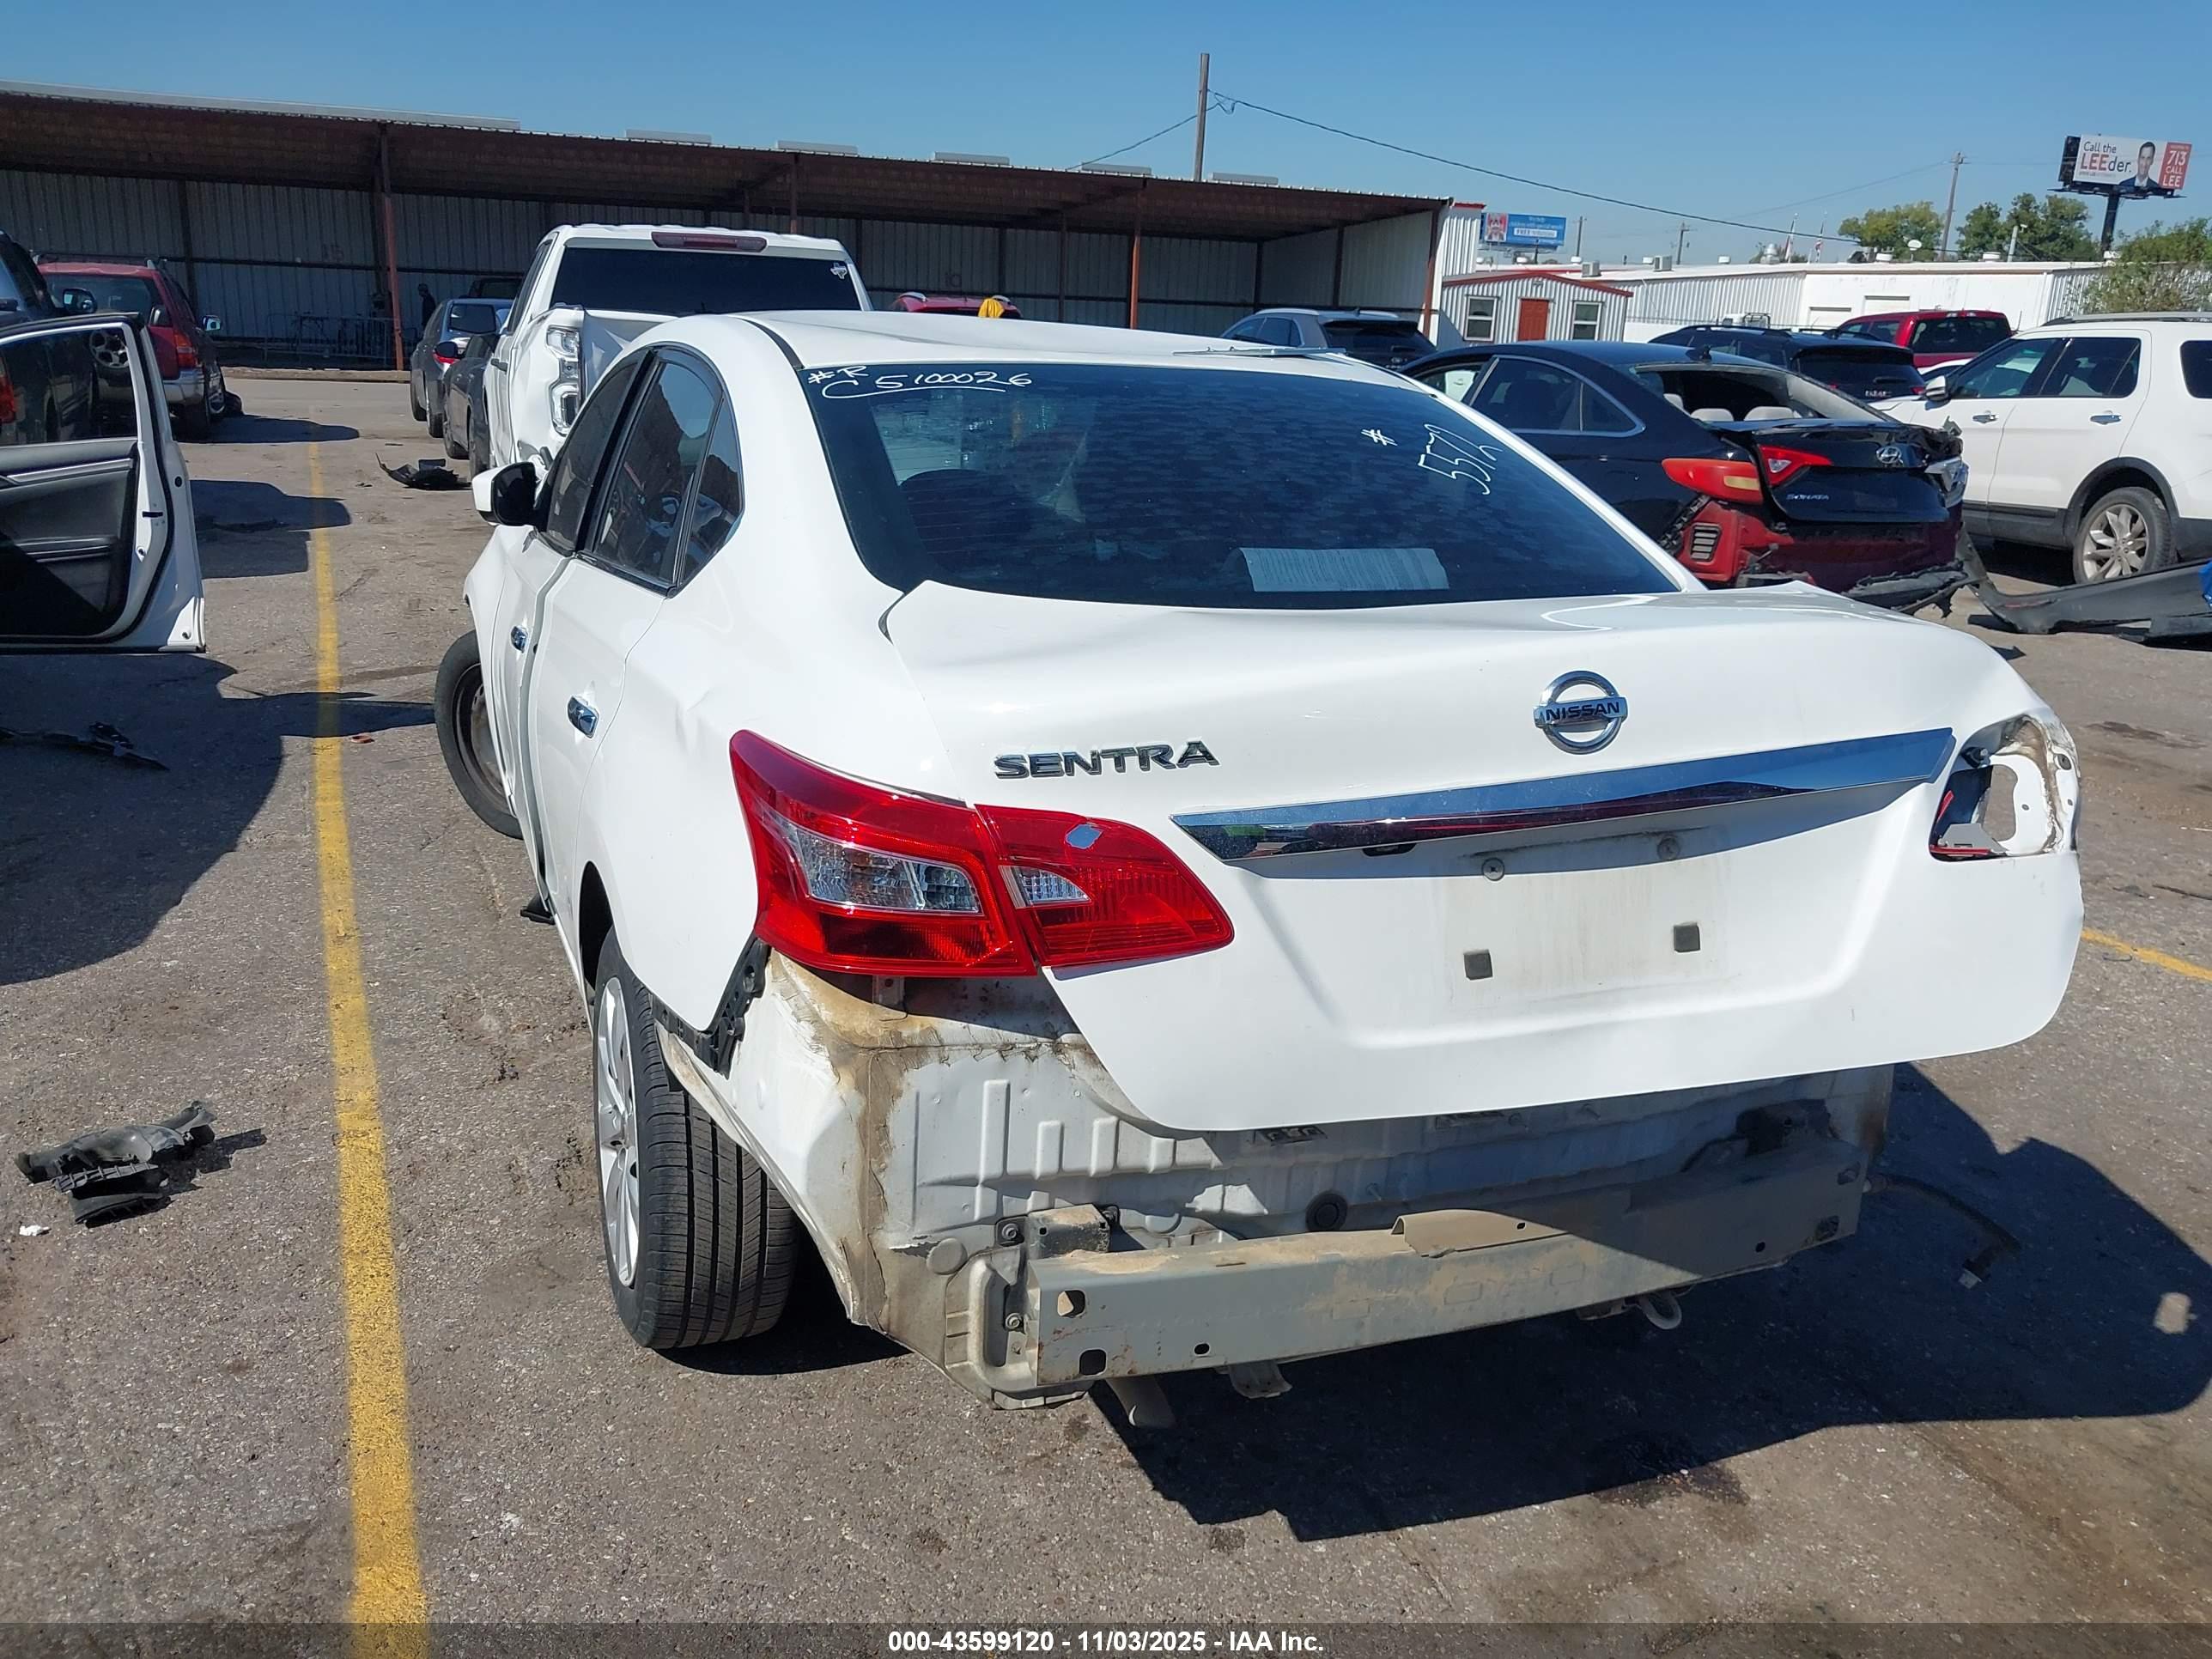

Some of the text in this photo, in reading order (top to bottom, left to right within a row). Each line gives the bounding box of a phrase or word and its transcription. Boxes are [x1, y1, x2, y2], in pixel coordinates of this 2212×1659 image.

[2083, 142, 2117, 153] Call the
[2080, 153, 2131, 173] LEEder.
[2166, 149, 2187, 166] 713
[2165, 166, 2184, 174] CALL
[2162, 174, 2181, 187] LEE
[1546, 701, 1620, 720] NISSAN
[994, 739, 1220, 779] SENTRA
